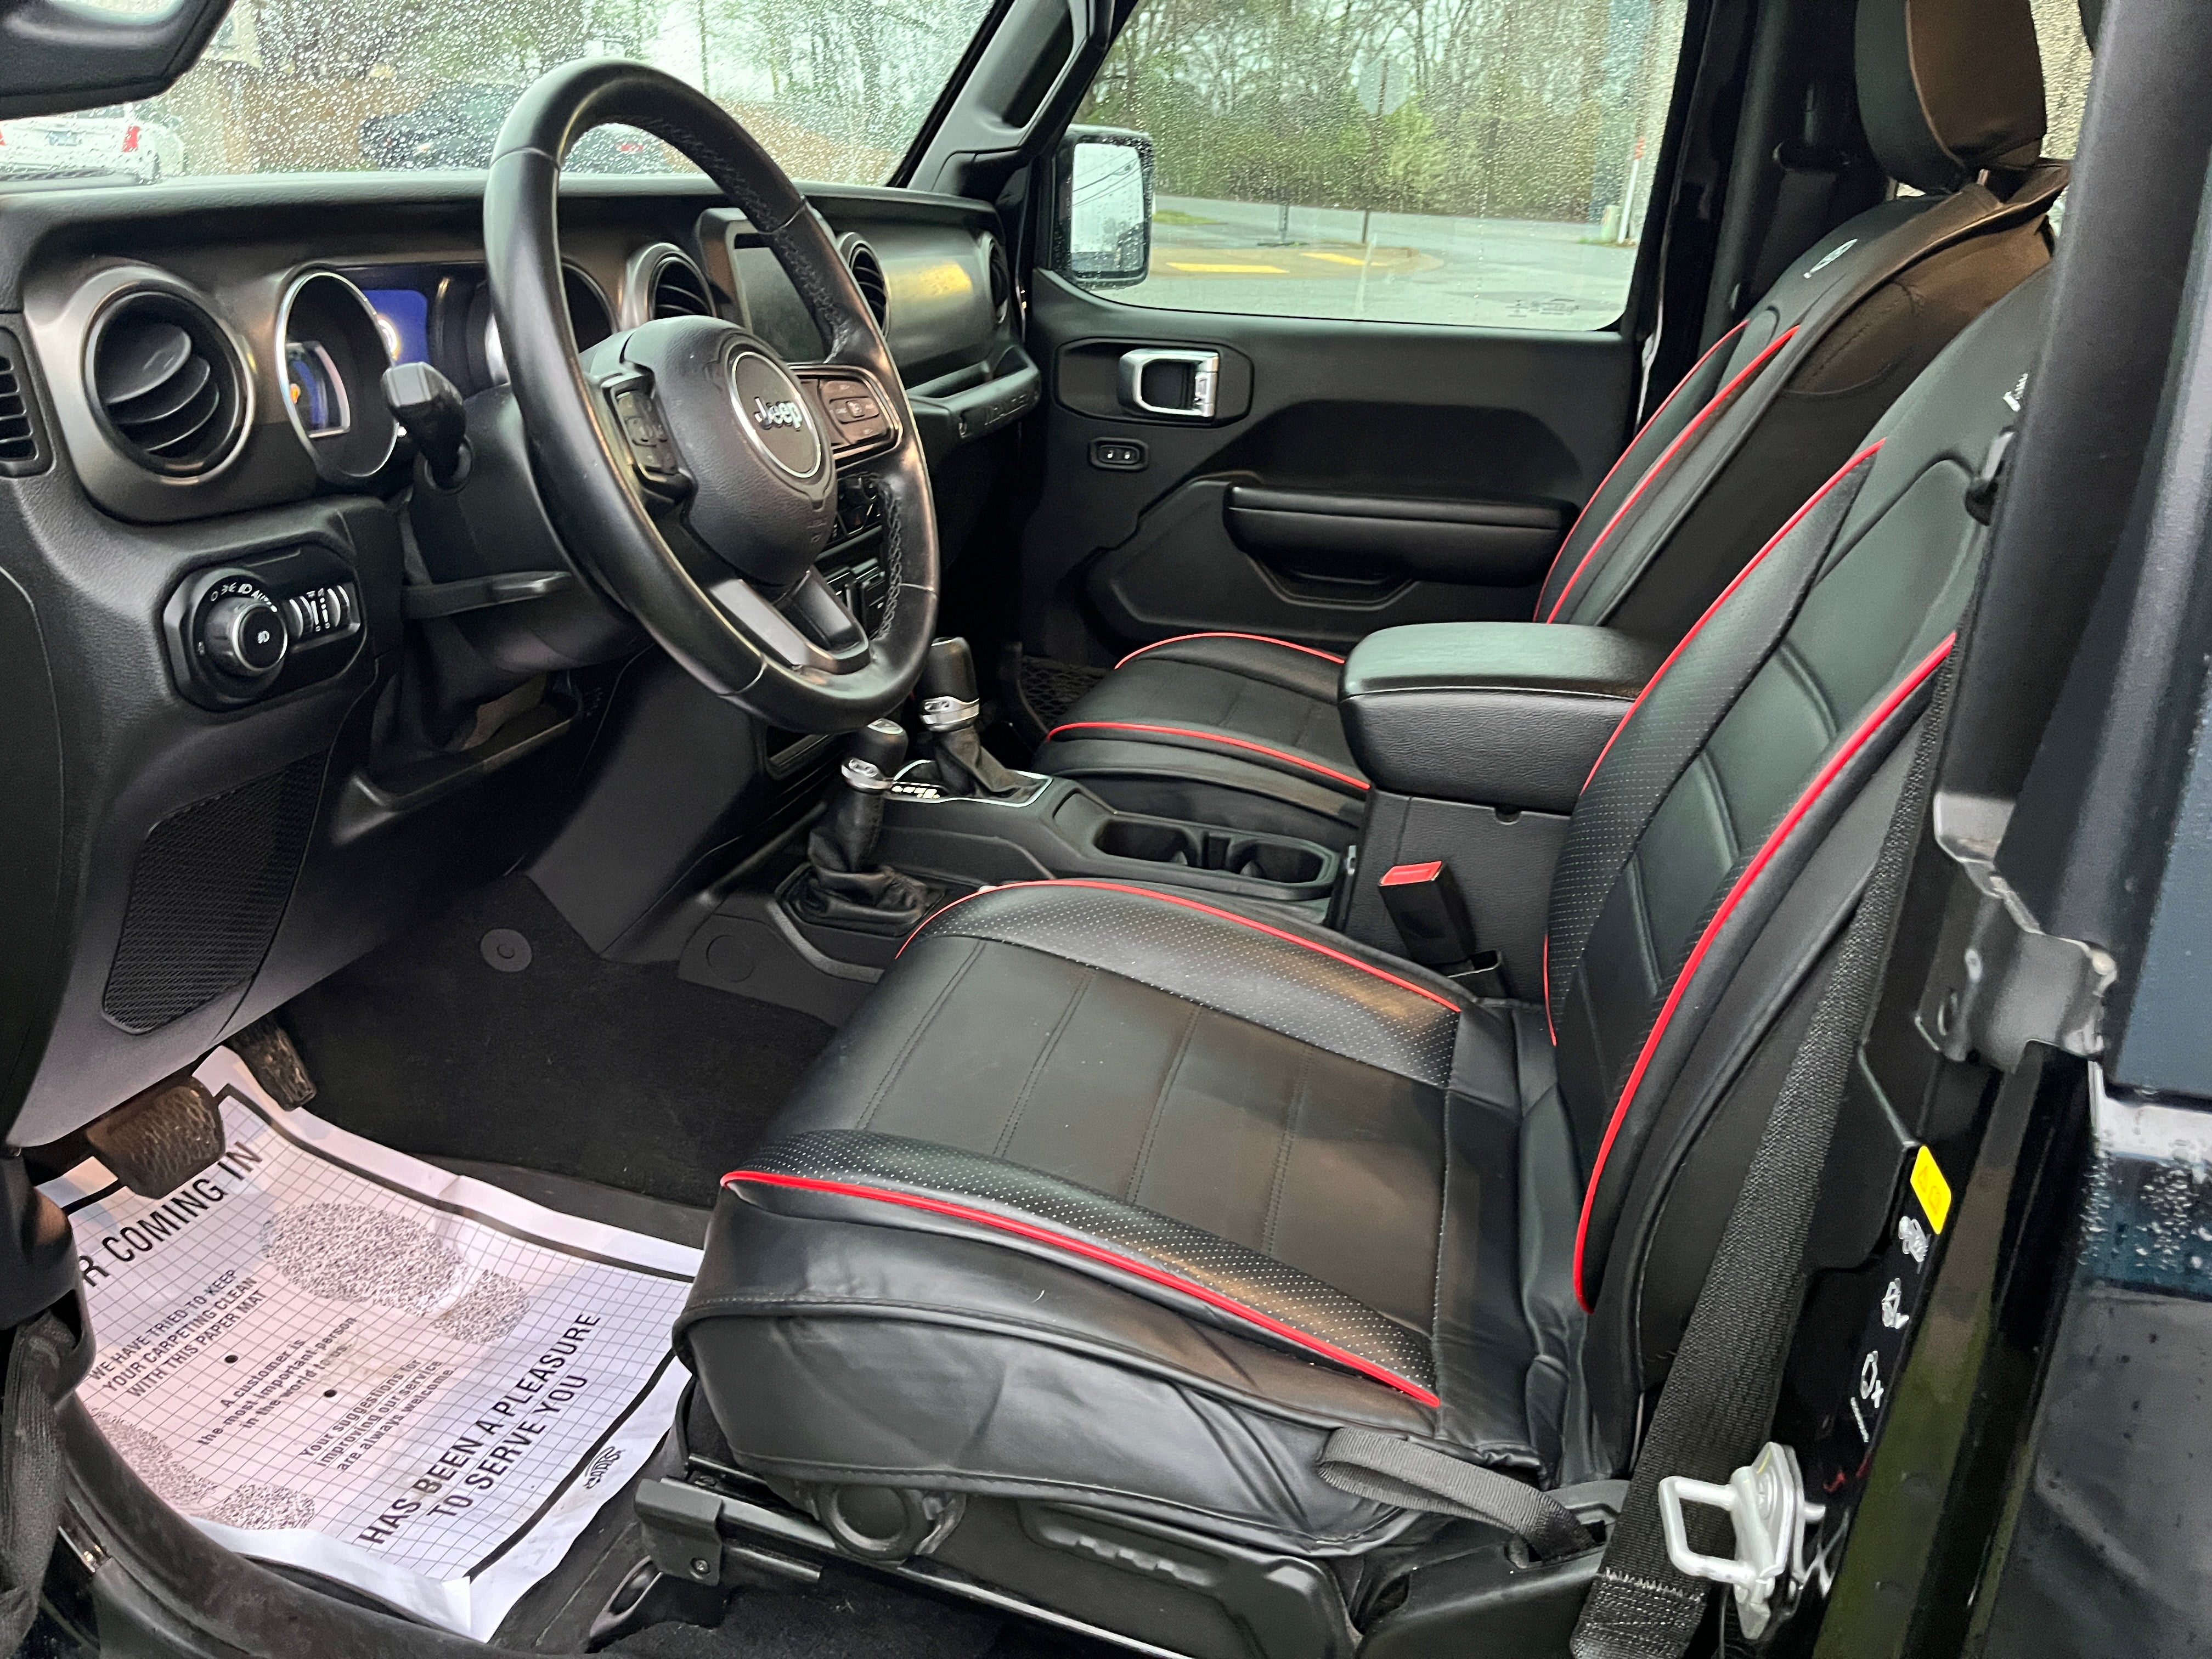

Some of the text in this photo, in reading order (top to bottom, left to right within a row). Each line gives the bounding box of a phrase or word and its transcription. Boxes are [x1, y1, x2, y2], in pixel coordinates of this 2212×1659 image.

[754, 396, 802, 428] Jeep
[102, 1179, 228, 1262] COMING
[217, 1141, 262, 1180] IN
[89, 1269, 236, 1380] WE HAVE TRIED TO KEEP
[103, 1277, 257, 1391] YOUR CARPETING CLEAN
[127, 1290, 267, 1397] WITH THIS PAPER MAT
[220, 1339, 306, 1408] A customer is
[198, 1317, 357, 1445] the most important person
[240, 1417, 259, 1429] in
[256, 1399, 281, 1415] the
[279, 1369, 317, 1398] world
[313, 1358, 331, 1370] to
[299, 1359, 421, 1456] Your suggestions for
[313, 1361, 442, 1467] improving our service
[358, 1314, 601, 1545] HAS BEEN A PLEASURE
[337, 1452, 361, 1471] are
[359, 1414, 405, 1450] always
[426, 1375, 588, 1517] TO SERVE YOU
